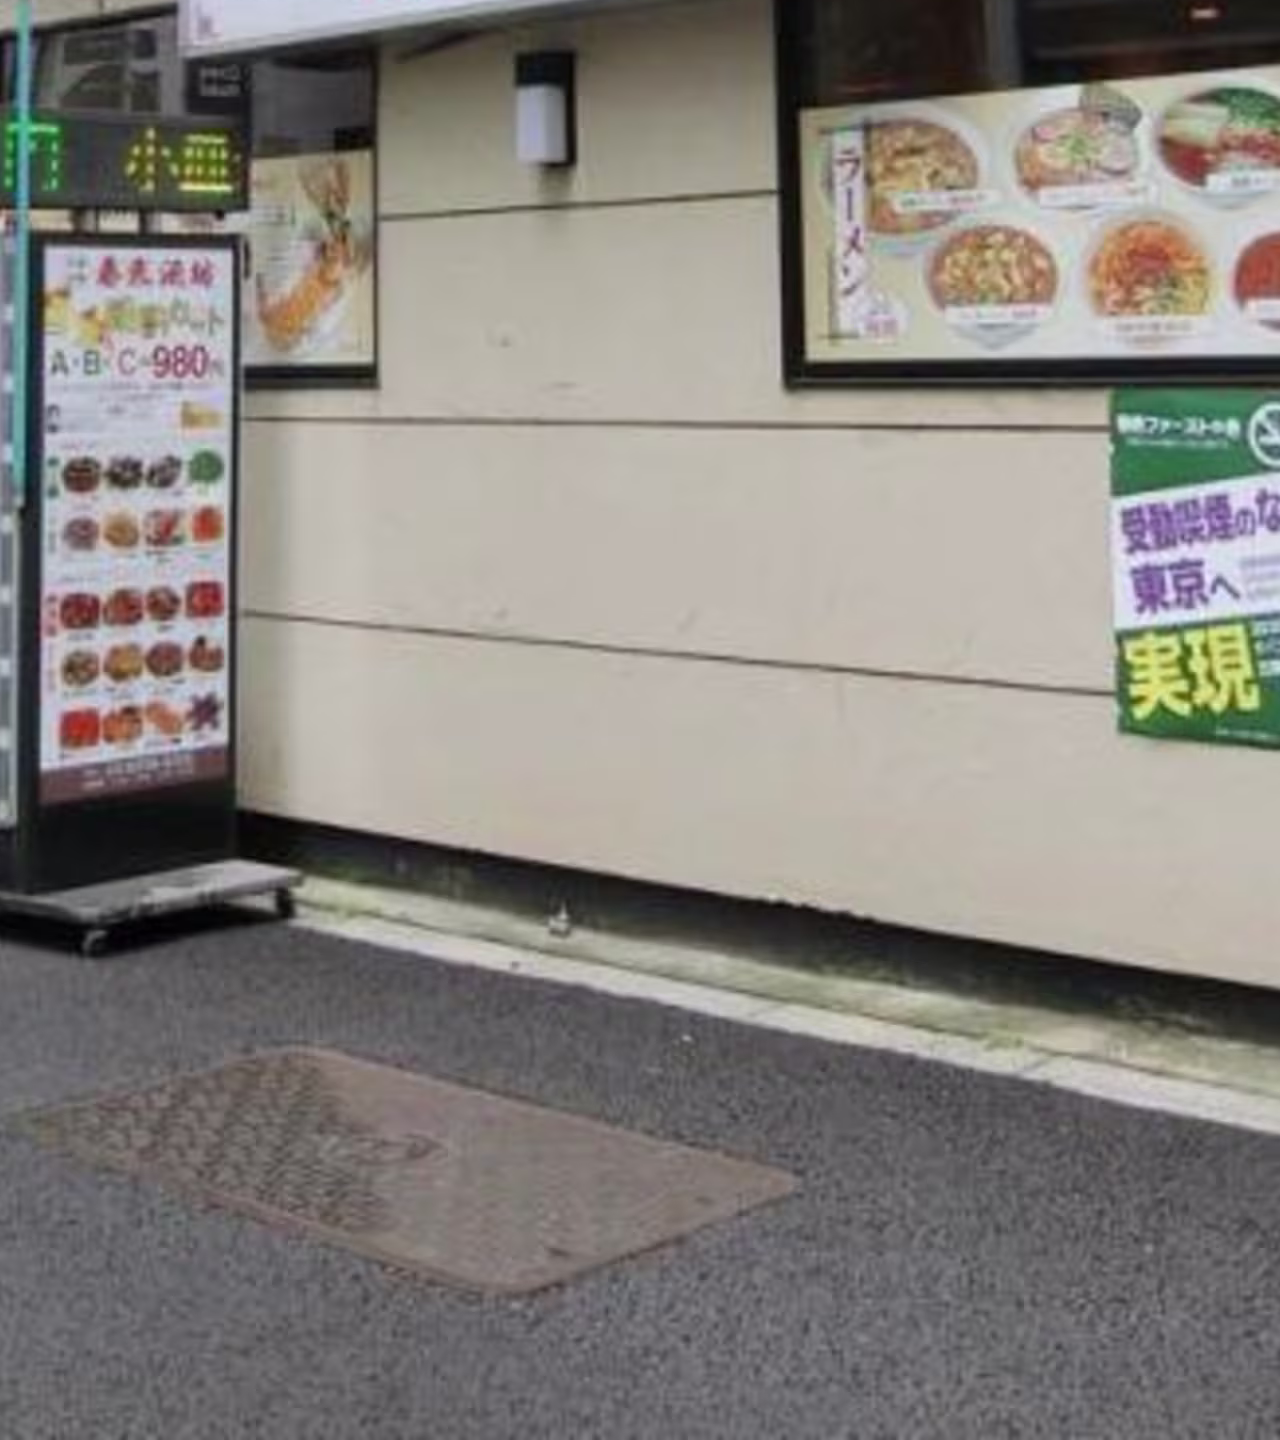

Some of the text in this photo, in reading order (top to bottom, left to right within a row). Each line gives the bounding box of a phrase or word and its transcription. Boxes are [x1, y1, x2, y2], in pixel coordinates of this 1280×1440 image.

[1130, 558, 1241, 615] 東京へ
[1122, 622, 1262, 721] 実現
